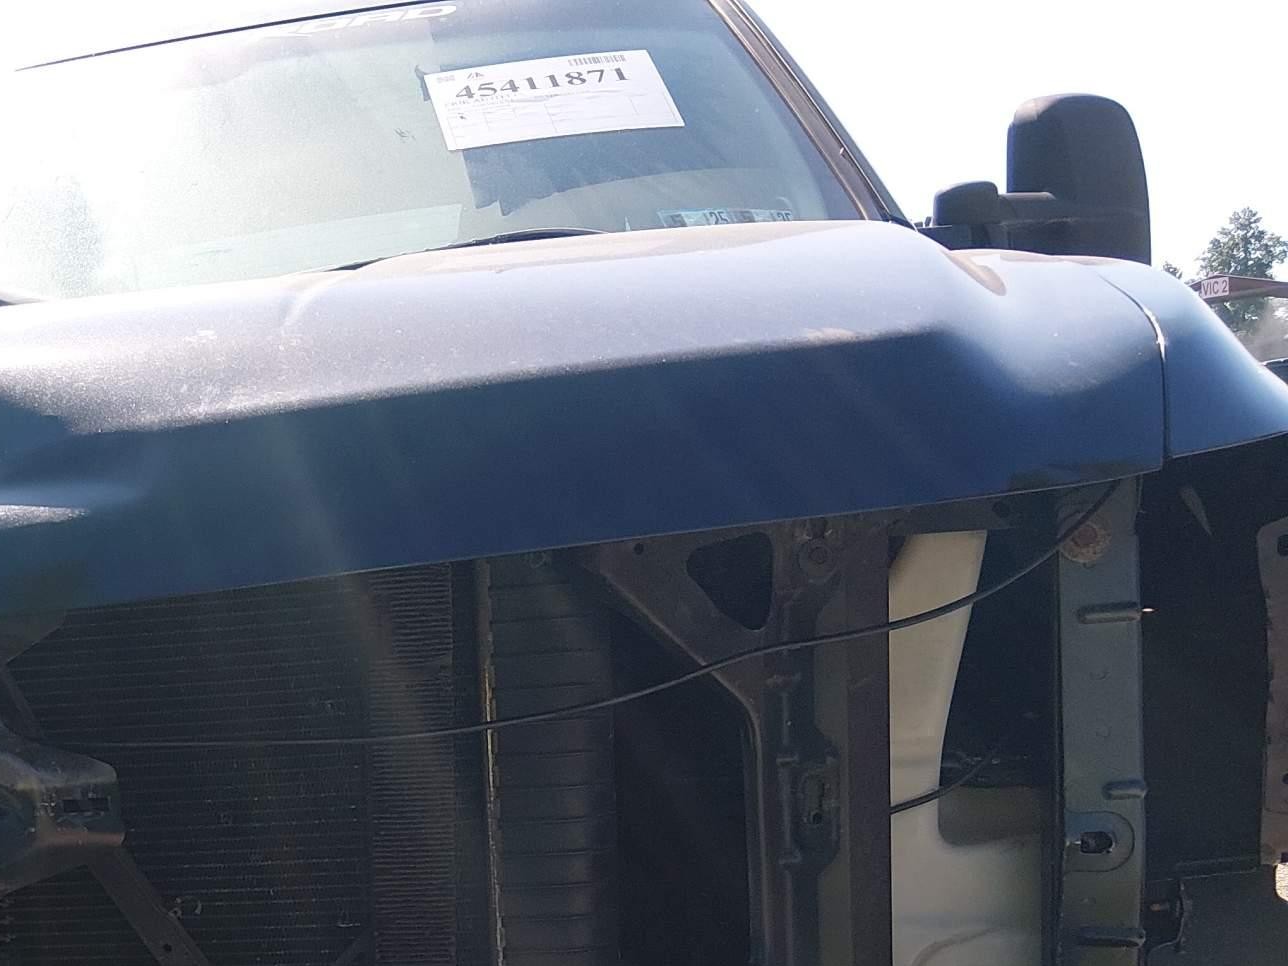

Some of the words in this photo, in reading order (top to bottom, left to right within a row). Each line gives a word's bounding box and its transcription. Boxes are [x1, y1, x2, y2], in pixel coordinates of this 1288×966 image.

[455, 66, 629, 99] 45411871
[1202, 281, 1219, 296] VIC
[1221, 279, 1228, 294] 2
